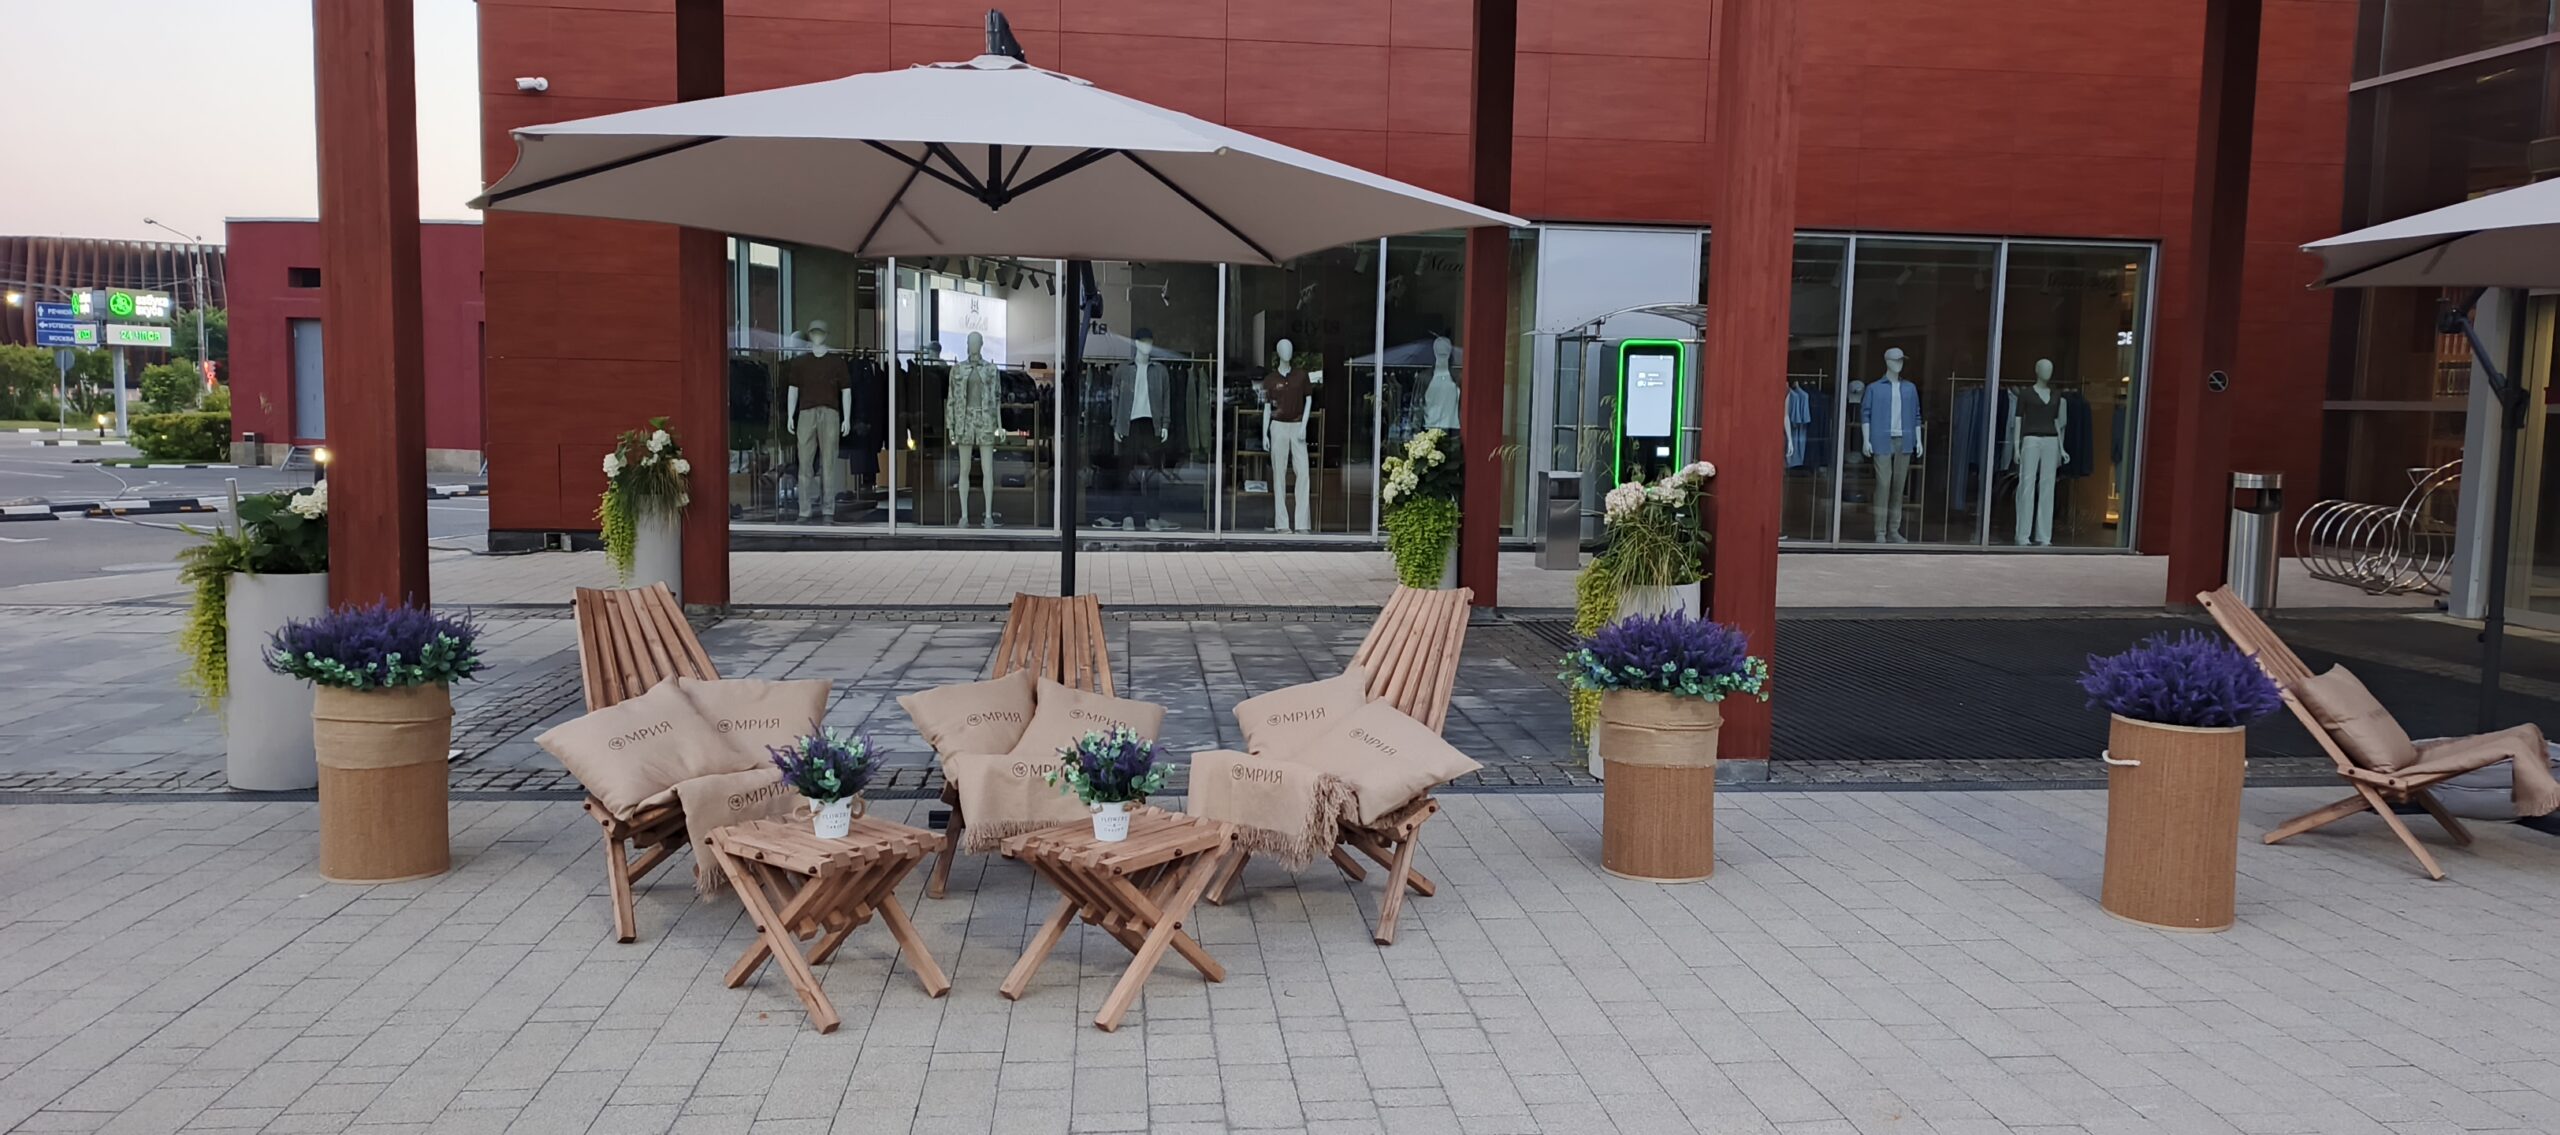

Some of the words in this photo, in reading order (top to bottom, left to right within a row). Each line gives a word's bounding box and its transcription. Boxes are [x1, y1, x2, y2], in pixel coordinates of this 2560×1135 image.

[121, 330, 132, 341] 24
[982, 711, 1022, 723] МРИЯ
[1283, 707, 1326, 724] МРИЯ
[625, 720, 673, 743] МРИЯ
[734, 718, 780, 731] МРИЯ
[1362, 733, 1398, 756] МРИЯ
[1030, 764, 1064, 778] МРИ
[1245, 768, 1283, 785] МРИЯ
